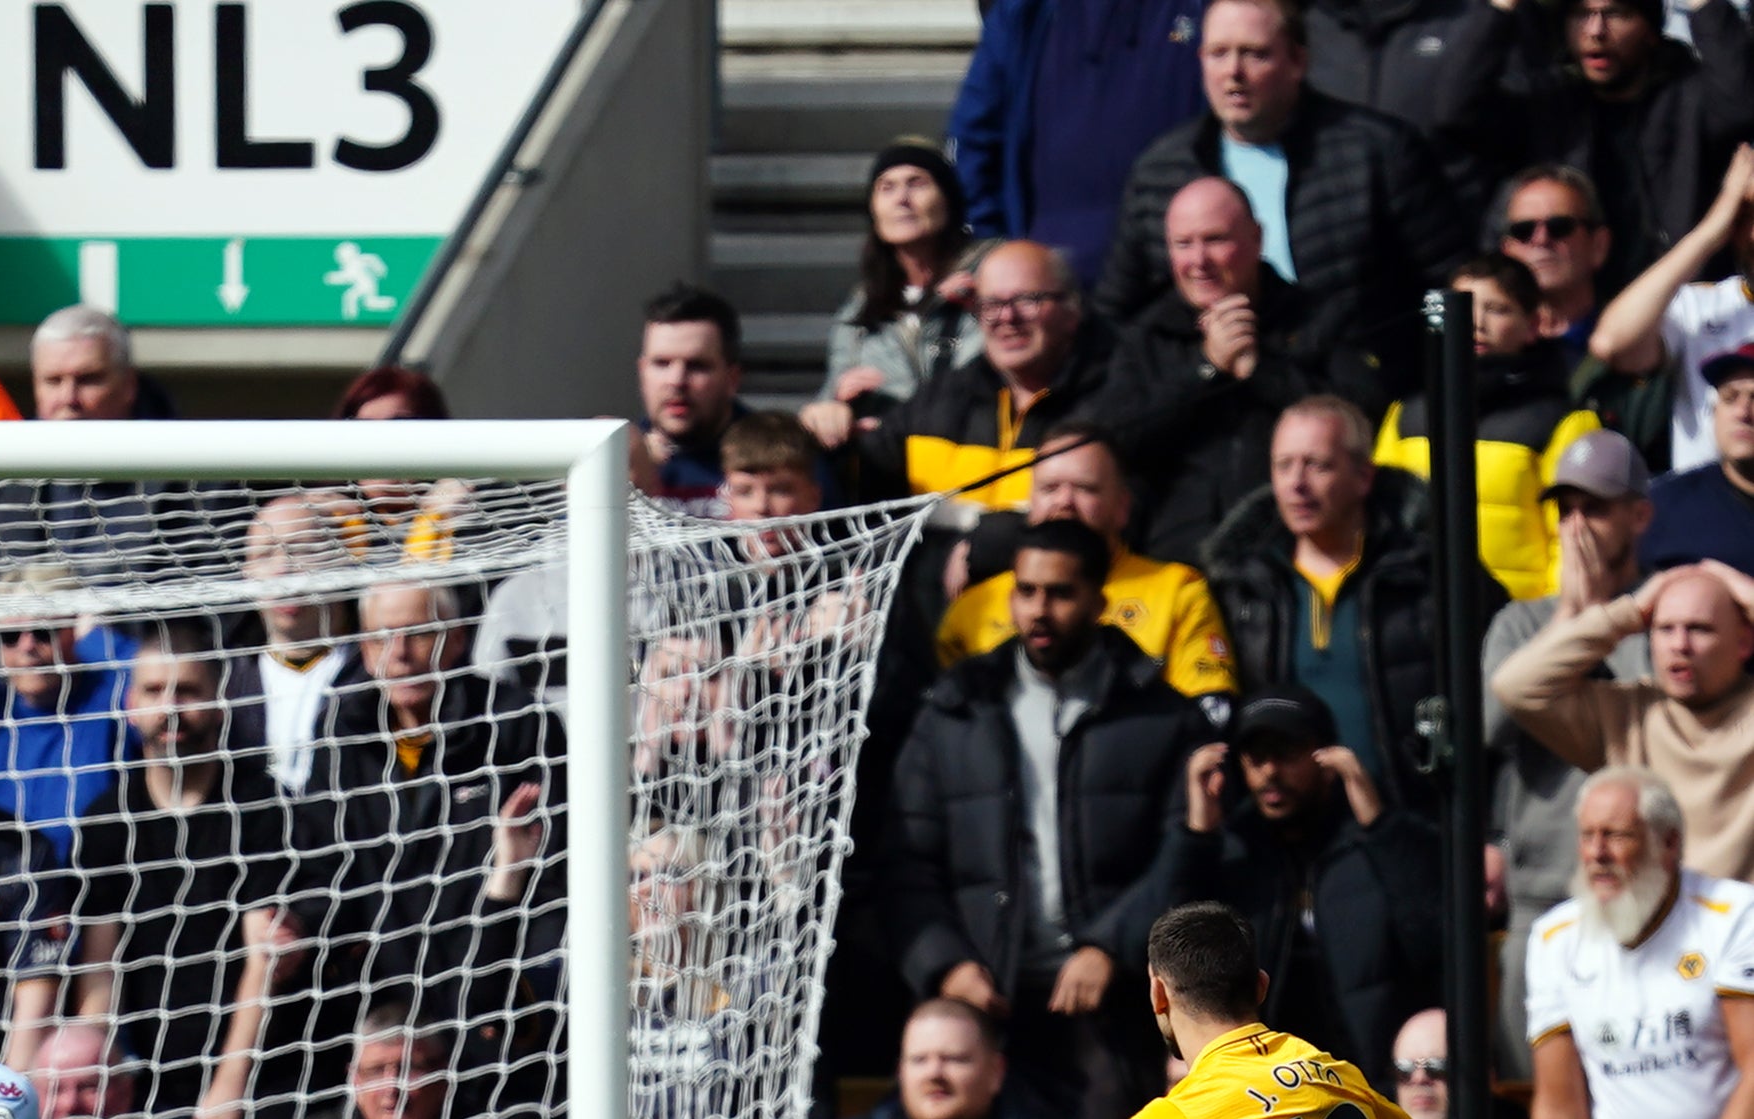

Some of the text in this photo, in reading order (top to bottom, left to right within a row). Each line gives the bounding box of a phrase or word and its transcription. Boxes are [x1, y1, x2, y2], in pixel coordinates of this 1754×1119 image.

[35, 0, 440, 172] NL3
[1247, 1058, 1343, 1113] J. OTTO
